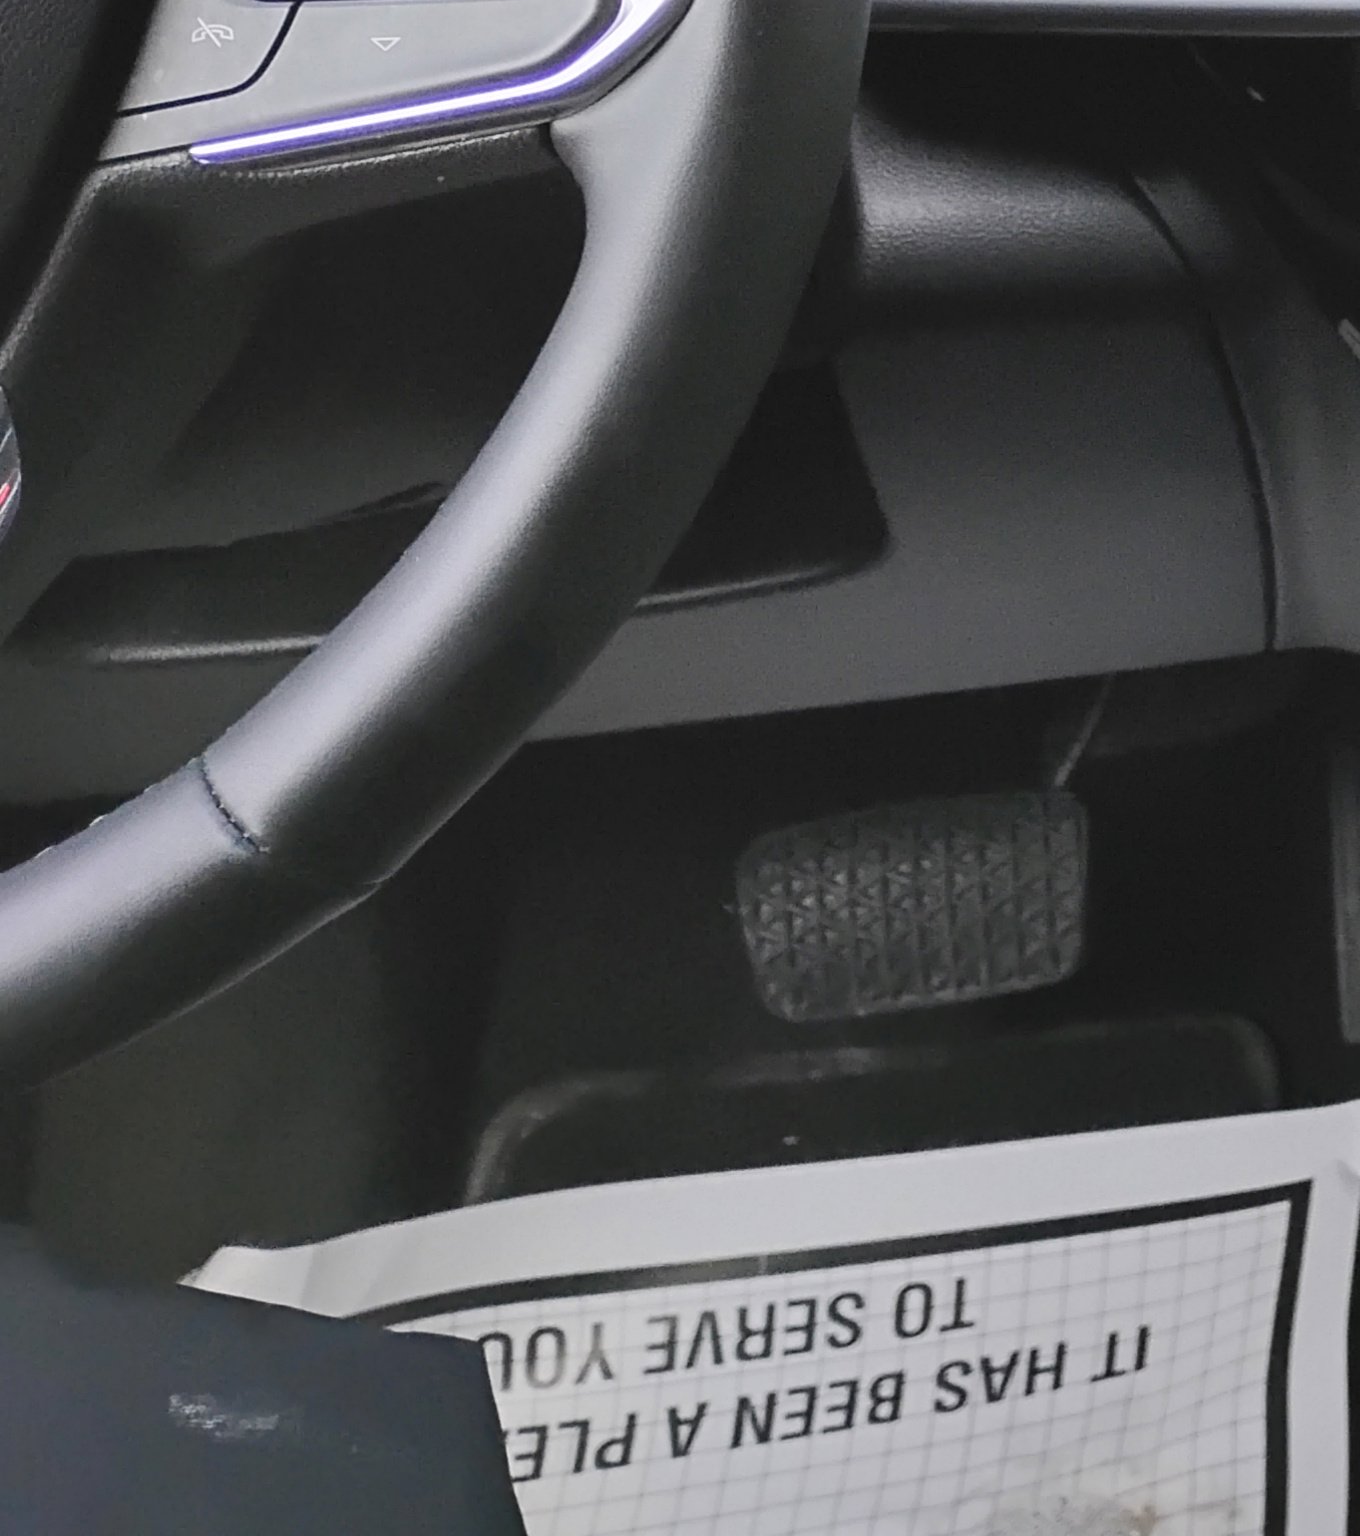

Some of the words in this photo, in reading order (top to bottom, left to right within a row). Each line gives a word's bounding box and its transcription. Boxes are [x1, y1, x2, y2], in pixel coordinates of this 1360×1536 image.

[643, 1291, 865, 1375] SERVE
[893, 1276, 975, 1339] TO
[478, 1321, 615, 1392] YOU
[934, 1340, 1067, 1413] HAS
[1090, 1324, 1152, 1383] IT
[667, 1401, 710, 1459] A
[729, 1368, 905, 1449] BEEN
[502, 1412, 638, 1483] PLE
